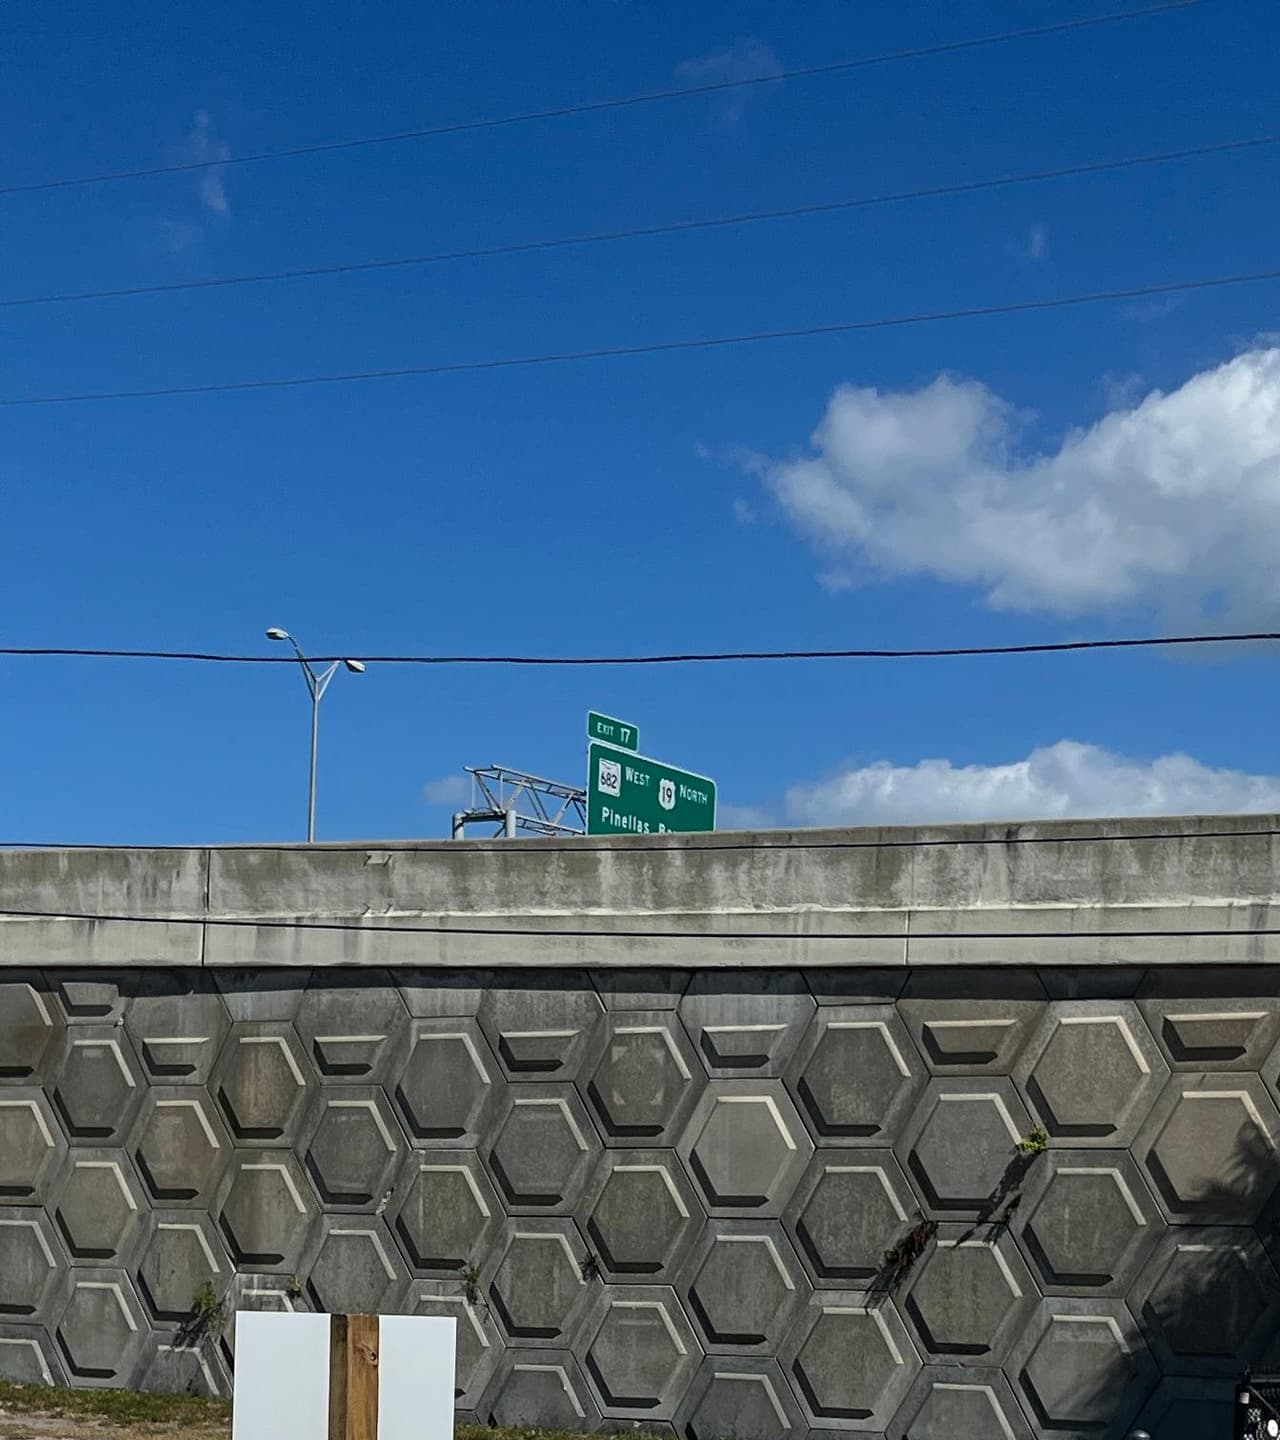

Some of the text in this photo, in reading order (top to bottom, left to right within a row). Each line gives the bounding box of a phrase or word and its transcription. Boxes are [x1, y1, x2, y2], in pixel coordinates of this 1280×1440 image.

[597, 722, 631, 744] EXIT 17
[601, 766, 708, 805] 682 WEST 19 NORTH
[602, 806, 650, 834] Pinellas
